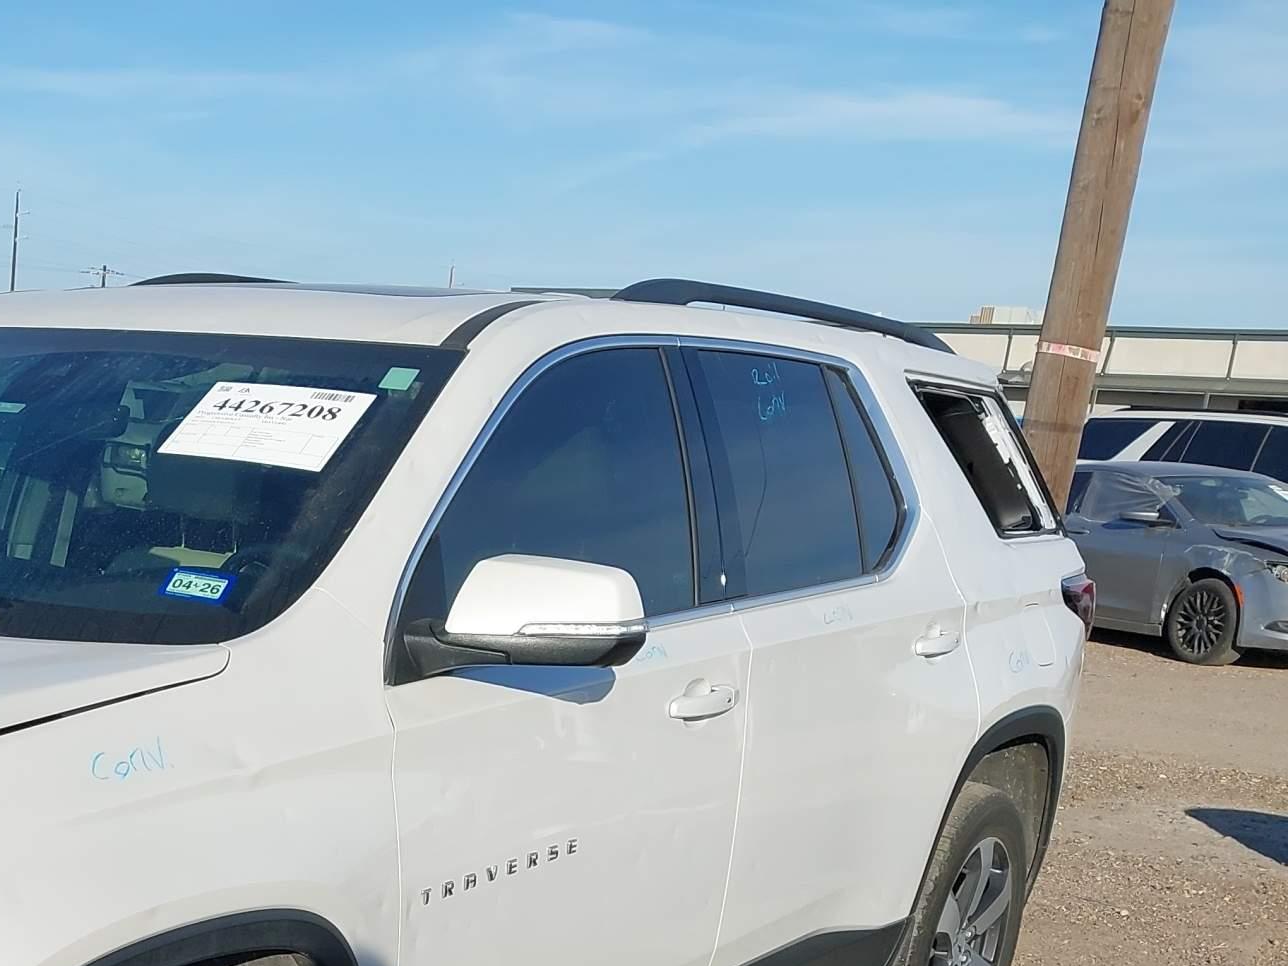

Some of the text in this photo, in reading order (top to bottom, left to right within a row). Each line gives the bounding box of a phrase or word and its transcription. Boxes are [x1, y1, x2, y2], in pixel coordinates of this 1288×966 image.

[212, 397, 342, 422] 44267208
[172, 578, 222, 595] 04 26
[420, 838, 578, 906] TRAVERSE
